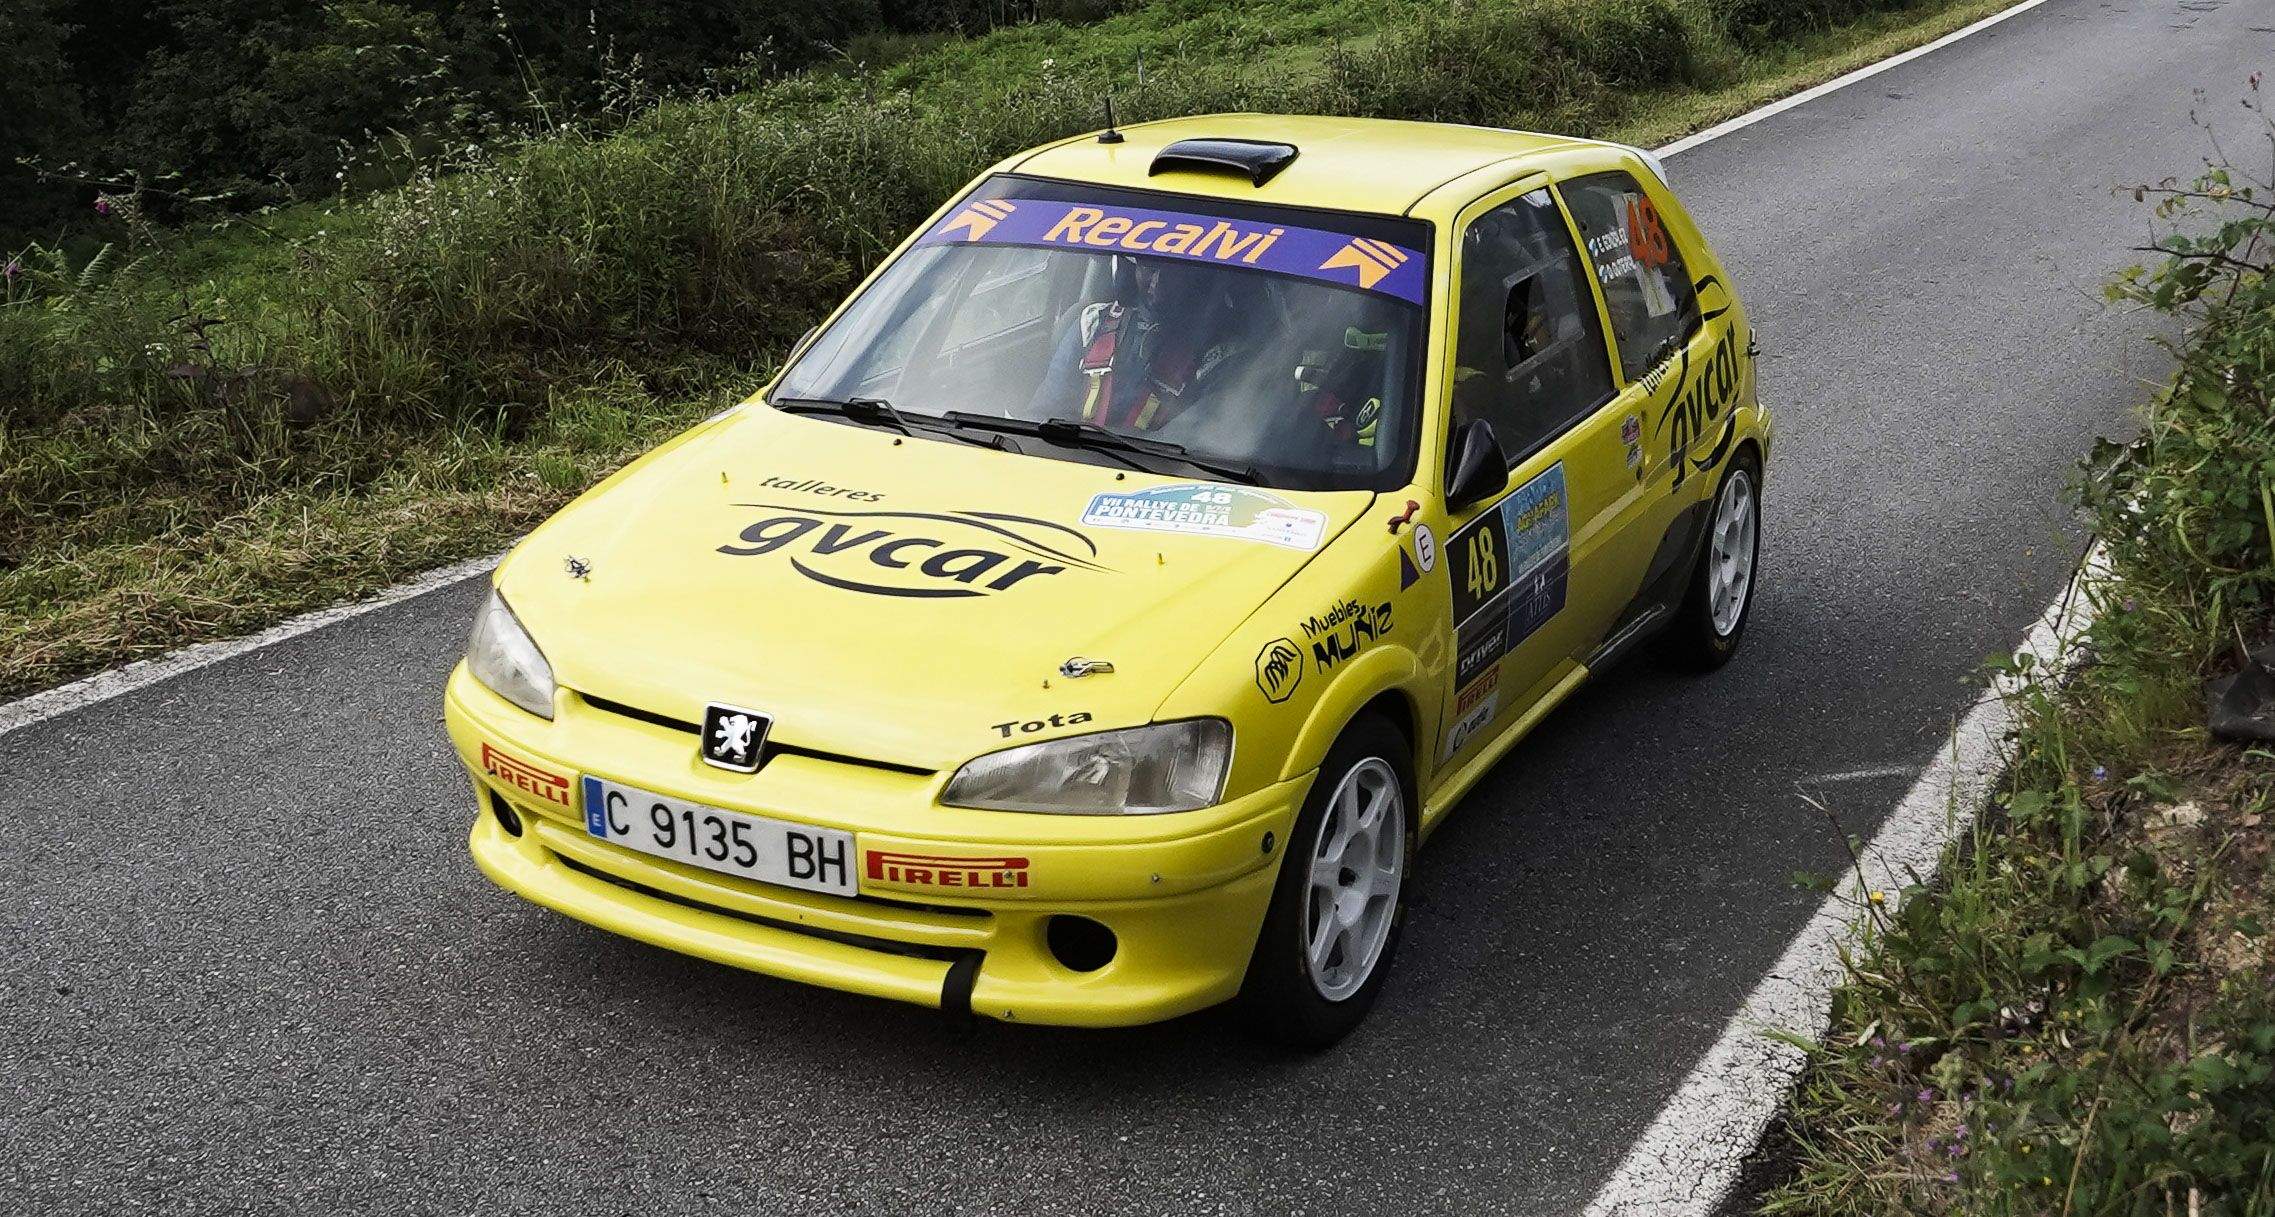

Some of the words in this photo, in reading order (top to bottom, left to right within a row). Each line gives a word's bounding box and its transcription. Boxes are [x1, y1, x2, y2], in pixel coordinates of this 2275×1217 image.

[1043, 206, 1285, 264] Recalvi
[1627, 194, 1668, 270] 48
[1670, 321, 1739, 495] gvcar
[760, 474, 886, 504] talleres
[1102, 497, 1124, 507] VII
[1124, 498, 1178, 511] RALLYE
[1179, 502, 1201, 512] DE
[1190, 491, 1232, 504] 48
[1095, 504, 1230, 526] PONTEVEDRA
[715, 514, 1067, 592] gvcar
[1419, 533, 1431, 562] E
[1467, 525, 1498, 601] 48
[1300, 598, 1360, 640] Muebles
[992, 709, 1093, 738] Tota
[482, 741, 570, 806] PIRELLI
[606, 791, 630, 836] C
[651, 803, 758, 869] 9135
[787, 831, 847, 886] BH
[866, 850, 1030, 888] PIRELLI
